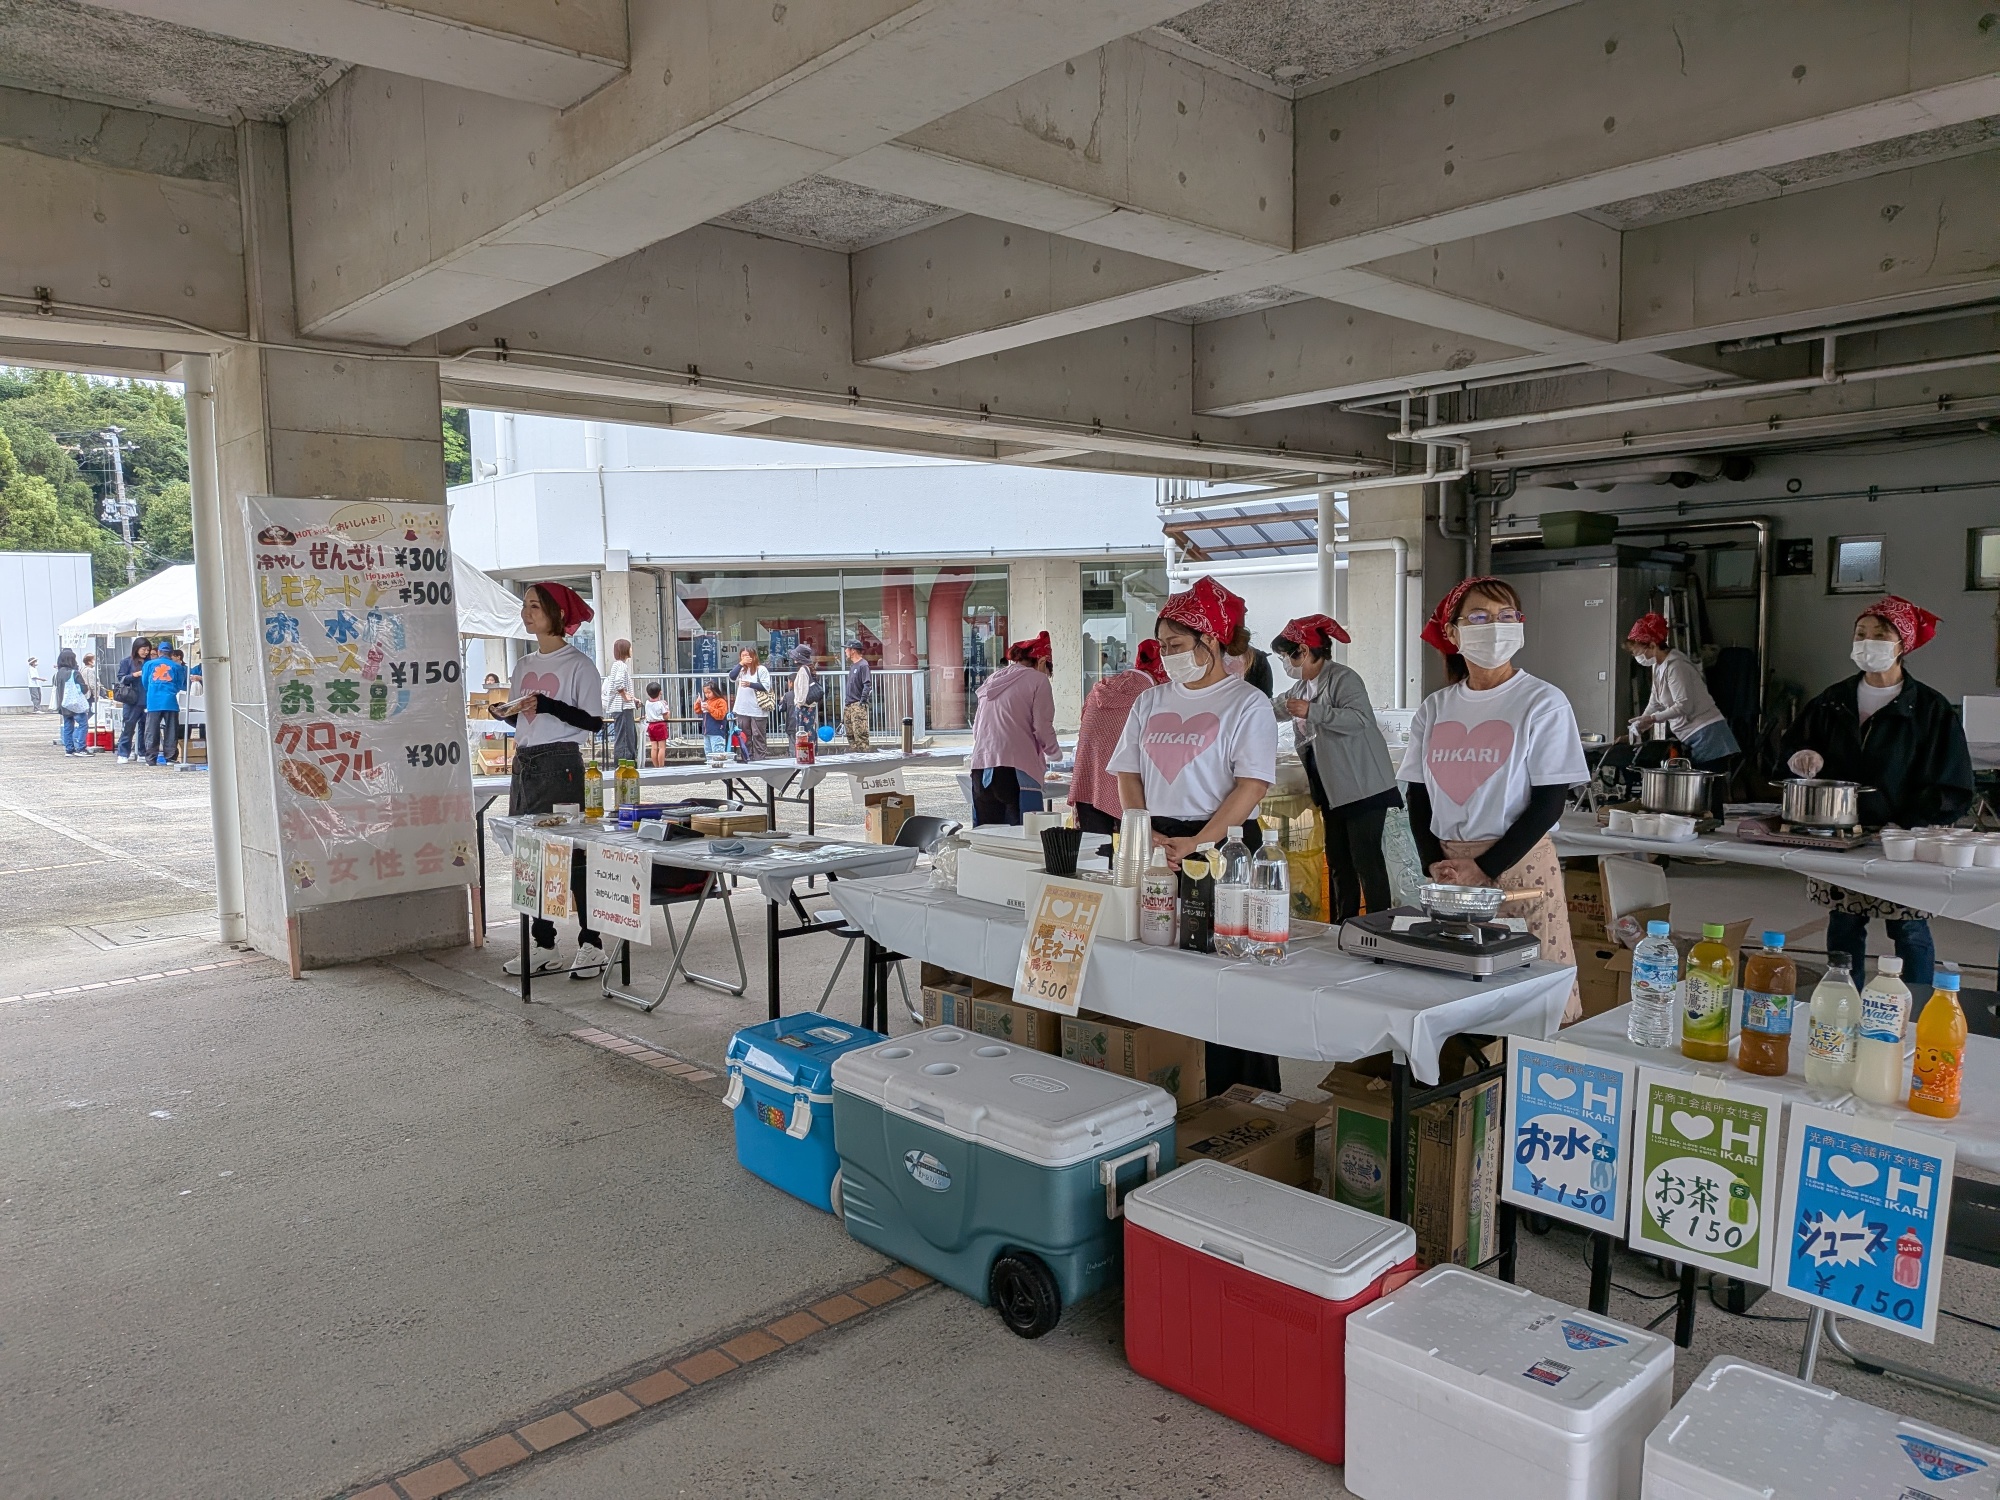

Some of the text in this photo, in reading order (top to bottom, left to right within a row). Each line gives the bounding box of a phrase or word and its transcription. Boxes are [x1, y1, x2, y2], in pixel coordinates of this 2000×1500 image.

[336, 514, 386, 532] おいしいよ!!
[256, 542, 447, 572] 冷やし ぜんざい ¥300
[260, 575, 361, 608] レモネード
[399, 581, 451, 605] ¥500
[269, 644, 362, 676] ジュース
[389, 661, 460, 688] ¥150
[279, 679, 361, 714] お茶
[1146, 733, 1205, 747] HIKARI
[405, 742, 460, 767] ¥300
[1432, 748, 1500, 763] HIKARI
[328, 843, 445, 884] 女性会
[1073, 902, 1096, 925] H
[1030, 937, 1085, 962] レモネード
[1861, 1006, 1899, 1021] Water
[1862, 998, 1900, 1013] カルピス
[1815, 1029, 1840, 1042] レモン
[1522, 1066, 1617, 1116] I H
[1582, 1110, 1615, 1125] IKARI
[1653, 1090, 1763, 1123] 光商工会議所女性会
[1516, 1122, 1592, 1165] お水
[1652, 1103, 1760, 1157] I H
[1720, 1149, 1758, 1166] IKARI
[1809, 1131, 1935, 1173] 光商工会議所女性会
[1806, 1145, 1932, 1210] I H
[1655, 1168, 1720, 1215] お茶
[1884, 1199, 1928, 1220] IKARI
[1798, 1208, 1889, 1259] ジュース
[1898, 1244, 1922, 1252] Juice
